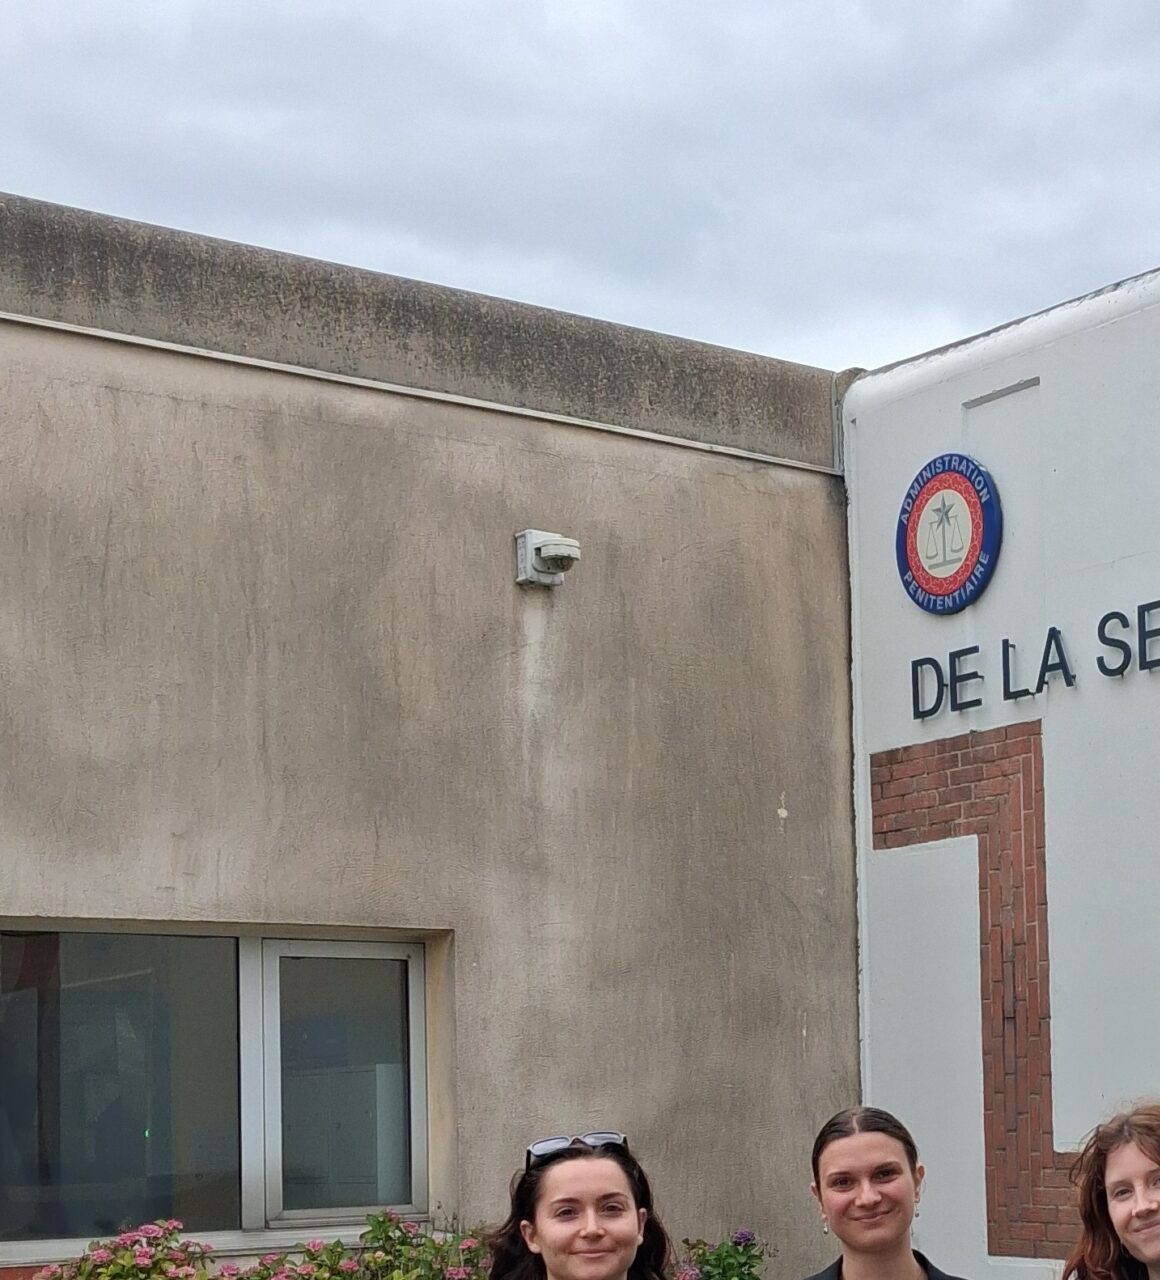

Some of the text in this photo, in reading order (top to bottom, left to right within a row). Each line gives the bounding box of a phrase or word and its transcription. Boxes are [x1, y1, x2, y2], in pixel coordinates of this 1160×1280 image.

[900, 456, 990, 525] ADMINISTRATION
[904, 552, 989, 610] PENITENTIAIRE
[911, 646, 983, 719] DE
[1002, 627, 1076, 700] LA
